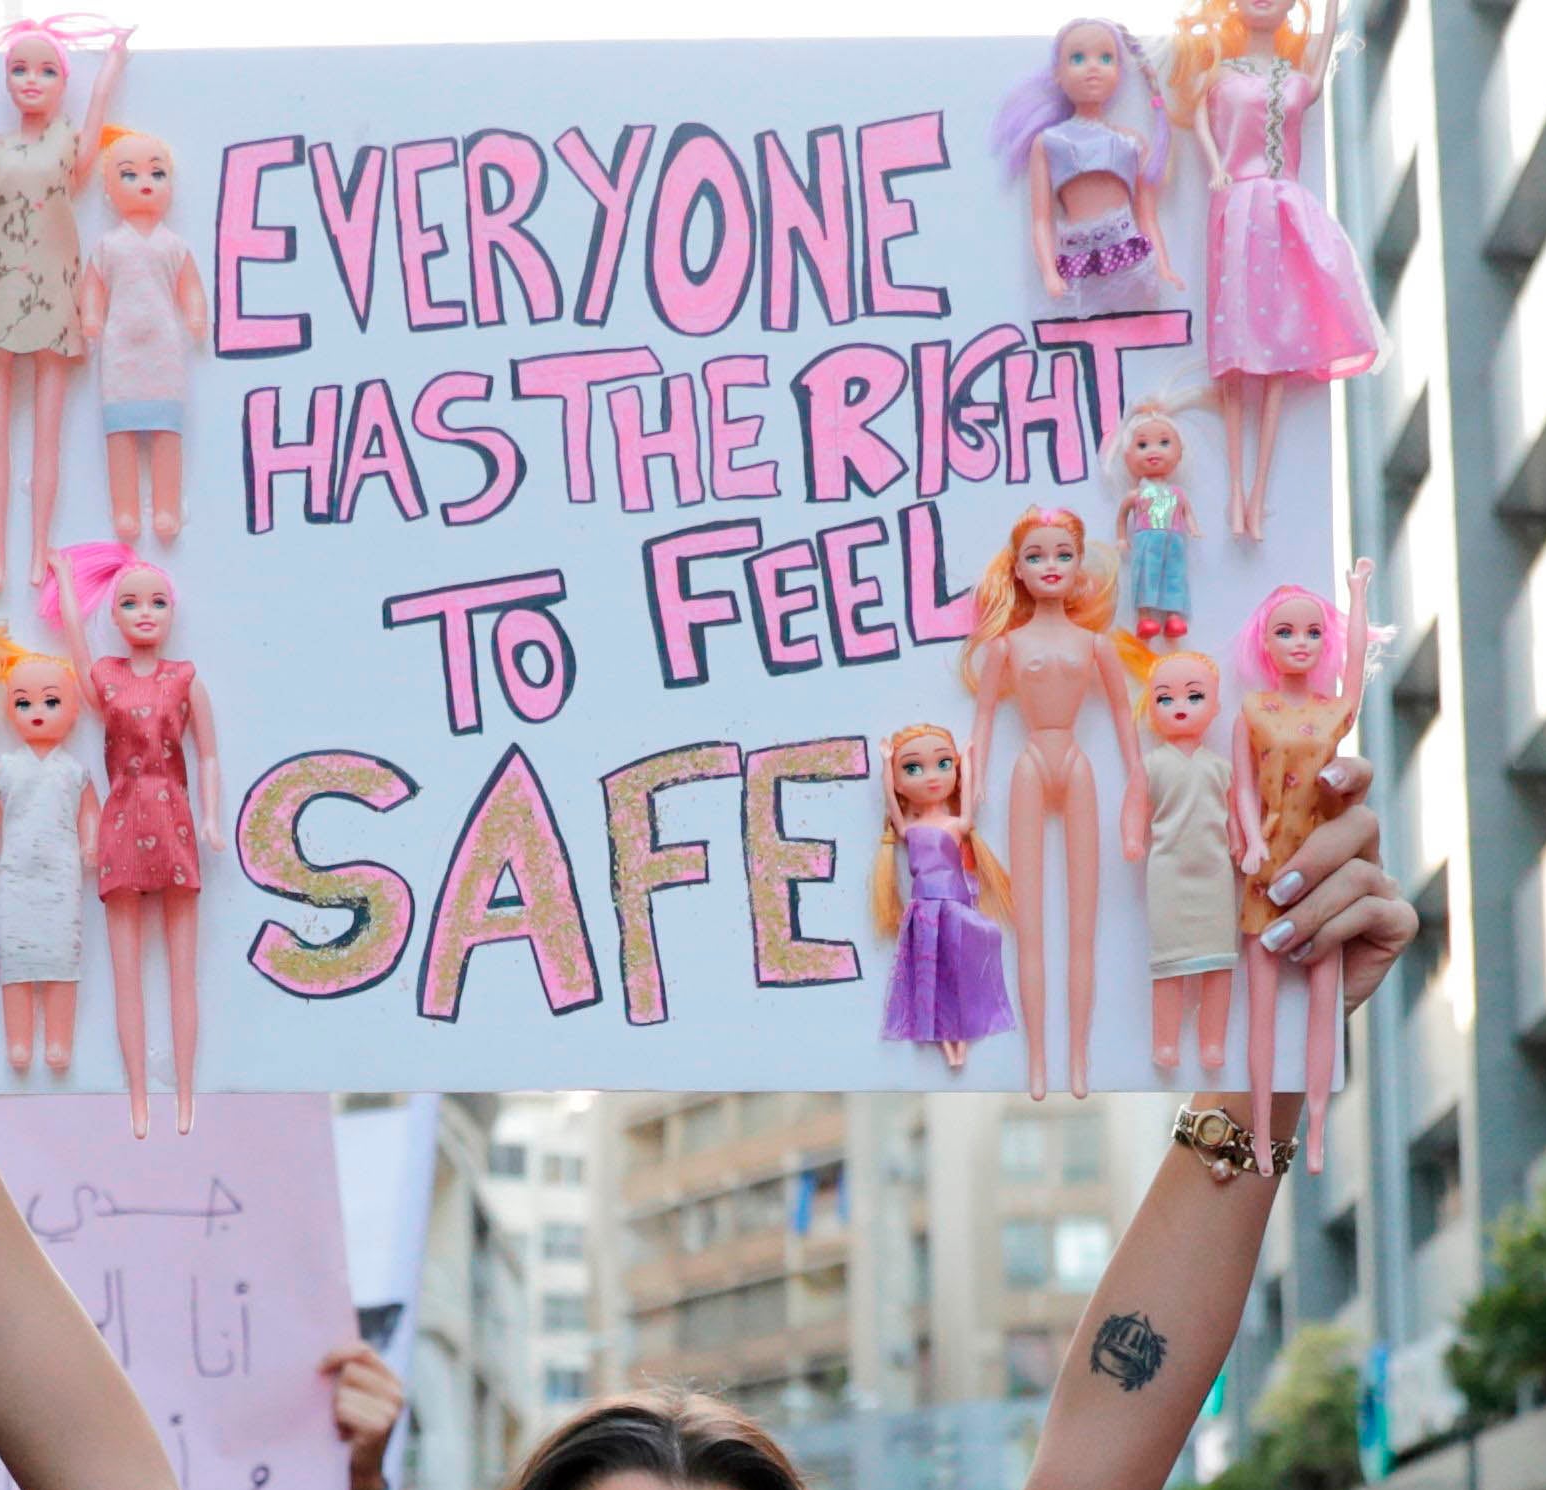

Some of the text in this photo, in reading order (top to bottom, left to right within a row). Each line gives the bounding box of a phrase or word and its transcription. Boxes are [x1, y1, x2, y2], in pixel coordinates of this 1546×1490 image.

[213, 111, 951, 358] EVERYONE
[243, 309, 1192, 534] HAS THE RIGHT
[383, 501, 976, 735] TO FEEL
[235, 735, 871, 1027] SAFE
